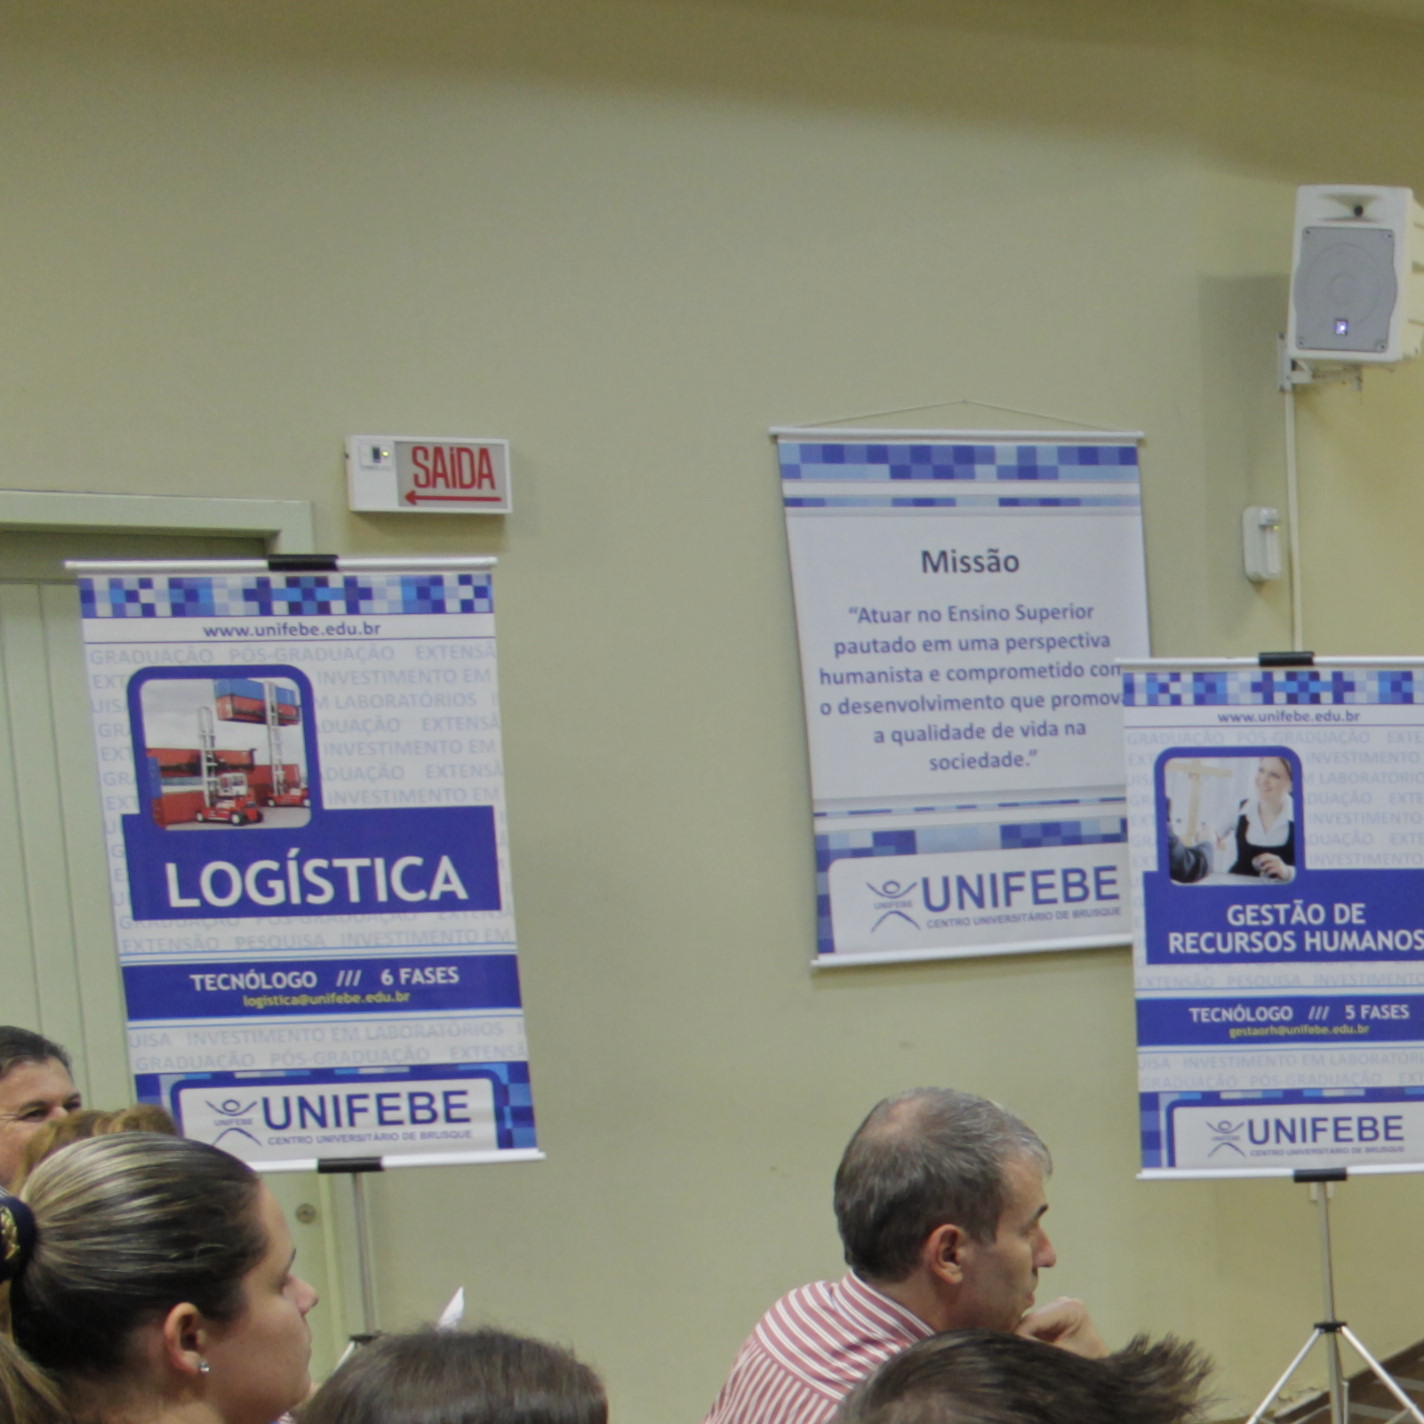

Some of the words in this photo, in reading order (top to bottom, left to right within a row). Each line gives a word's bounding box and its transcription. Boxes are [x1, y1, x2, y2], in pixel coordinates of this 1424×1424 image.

[411, 445, 497, 490] SAÍDA
[921, 547, 1020, 574] Missão
[918, 609, 942, 622] no
[948, 604, 1010, 622] Ensino
[1015, 602, 1094, 624] Superior
[202, 620, 381, 639] www.unifebe.edu.br
[90, 645, 214, 666] GRADUAÇÃO
[229, 643, 396, 664] PÓS-GRADUAÇÃO
[415, 641, 497, 662] EXTENSÃ
[834, 636, 916, 659] pautado
[922, 638, 952, 652] em
[958, 637, 999, 651] uma
[1005, 632, 1111, 654] perspectiva
[316, 668, 457, 686] INVESTIMENTO
[463, 667, 491, 684] EM
[819, 666, 923, 686] humanista
[929, 668, 940, 682] e
[946, 661, 1085, 684] comprometido
[335, 690, 477, 710] LABORATÓRIOS
[820, 702, 832, 716] o
[838, 693, 1005, 715] desenvolvimento
[1010, 695, 1045, 713] que
[1051, 692, 1124, 711] promov
[1217, 709, 1361, 723] www.unifebe.edu.br
[873, 730, 884, 744] a
[891, 722, 986, 746] qualidade
[992, 721, 1015, 739] de
[1020, 719, 1059, 738] vida
[1064, 722, 1087, 737] na
[322, 740, 463, 757] INVESTIMENTO
[468, 739, 496, 755] EM
[327, 788, 468, 806] INVESTIMENTO
[164, 847, 470, 908] LOGÍSTICA
[921, 864, 1120, 913] UNIFEBE
[926, 916, 971, 929] CENTRO
[973, 910, 1052, 927] UNIVERSITÁRIO
[1055, 909, 1069, 921] DE
[1072, 906, 1122, 920] BRUSQUE
[1227, 898, 1326, 926] GESTÃO
[1333, 902, 1366, 925] DE
[1168, 929, 1297, 954] RECURSOS
[189, 968, 318, 992] TECNÓLOGO
[380, 969, 394, 986] 6
[399, 966, 460, 985] FASES
[1189, 1003, 1294, 1023] TECNÓLOGO
[1345, 1004, 1356, 1020] 5
[1360, 1004, 1410, 1020] FASES
[186, 1027, 325, 1046] INVESTIMENTO
[331, 1026, 360, 1043] EM
[366, 1021, 504, 1041] LABORATÓRIOS
[135, 1053, 255, 1073] GRADUAÇÃO
[271, 1046, 430, 1068] PÓS-GRADUAÇÃO
[262, 1089, 471, 1130] UNIFEBE
[267, 1135, 314, 1146] CENTRO
[317, 1132, 400, 1145] UNIVERSITÁRIO
[403, 1131, 417, 1142] DE
[420, 1129, 473, 1141] BRUSQUE
[1247, 1115, 1404, 1145] UNIFEBE
